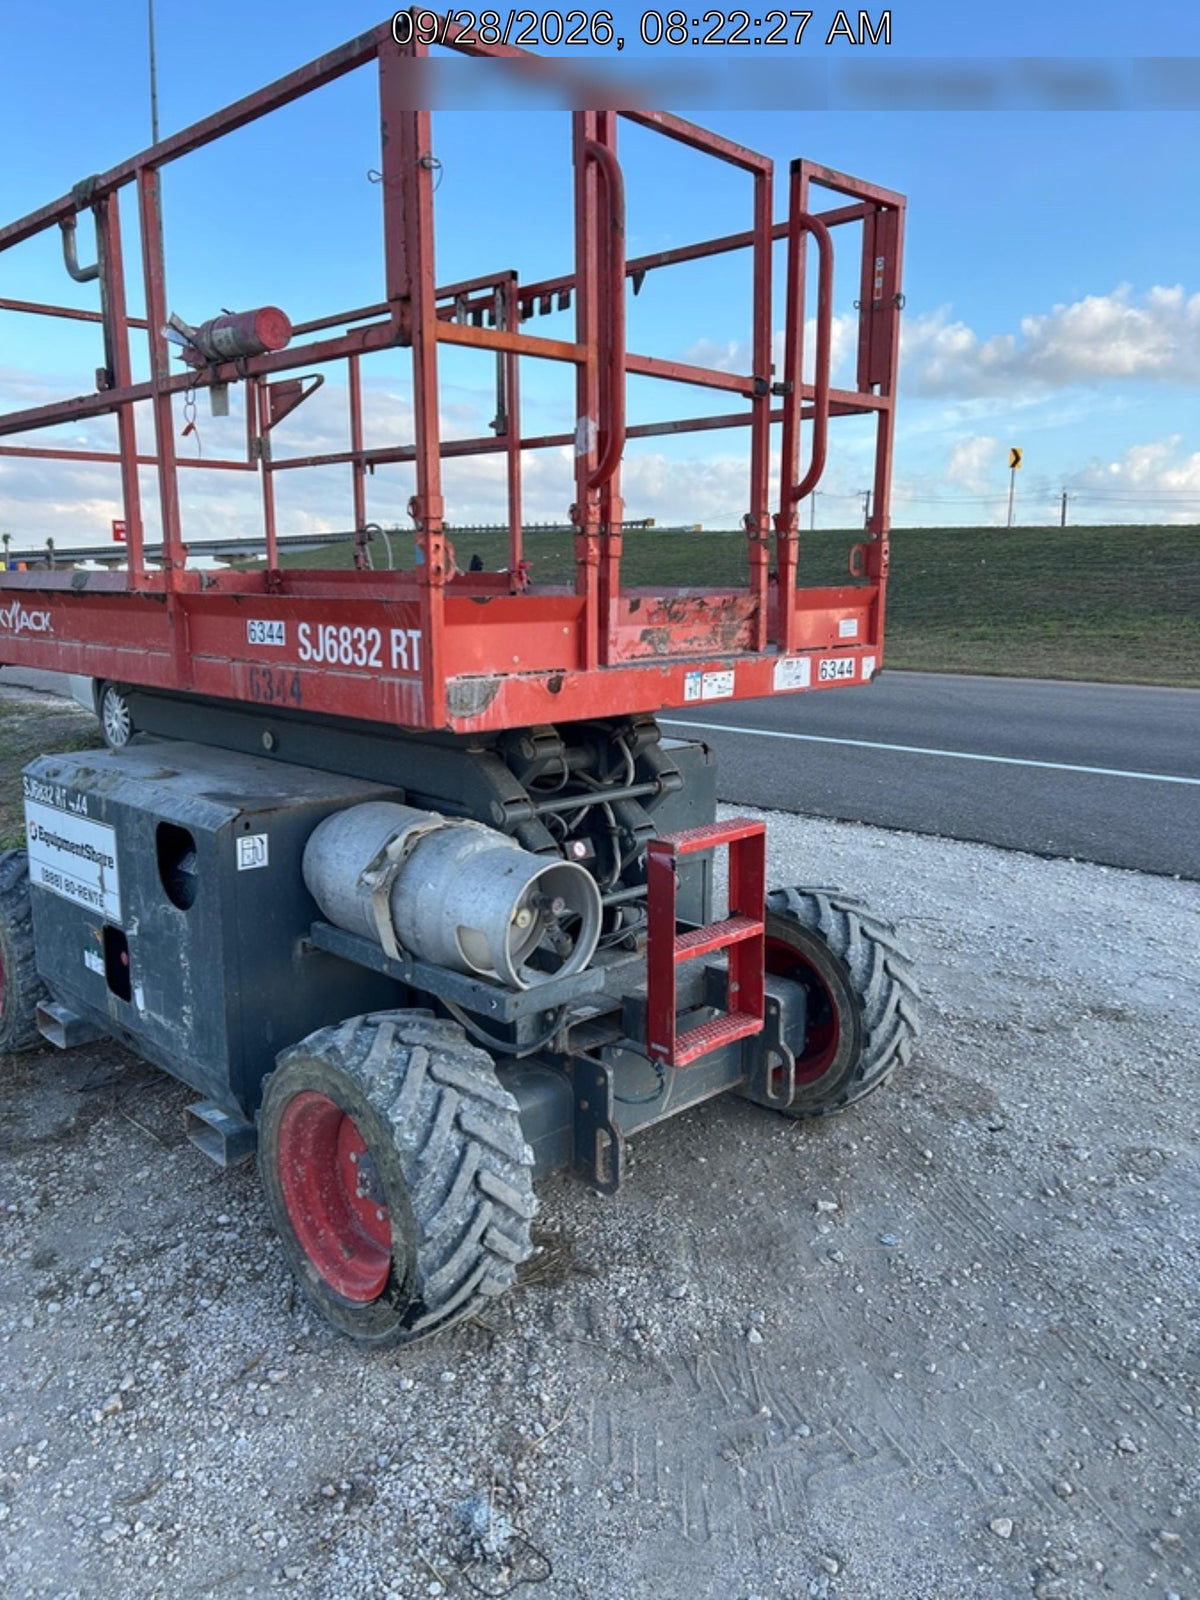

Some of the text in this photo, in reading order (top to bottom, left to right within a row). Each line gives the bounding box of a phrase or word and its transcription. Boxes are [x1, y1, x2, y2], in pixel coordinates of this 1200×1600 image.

[249, 621, 283, 644] 6344
[298, 622, 422, 671] SJ6832 RT
[819, 659, 853, 680] 6344
[38, 825, 114, 870] EquipmentShare
